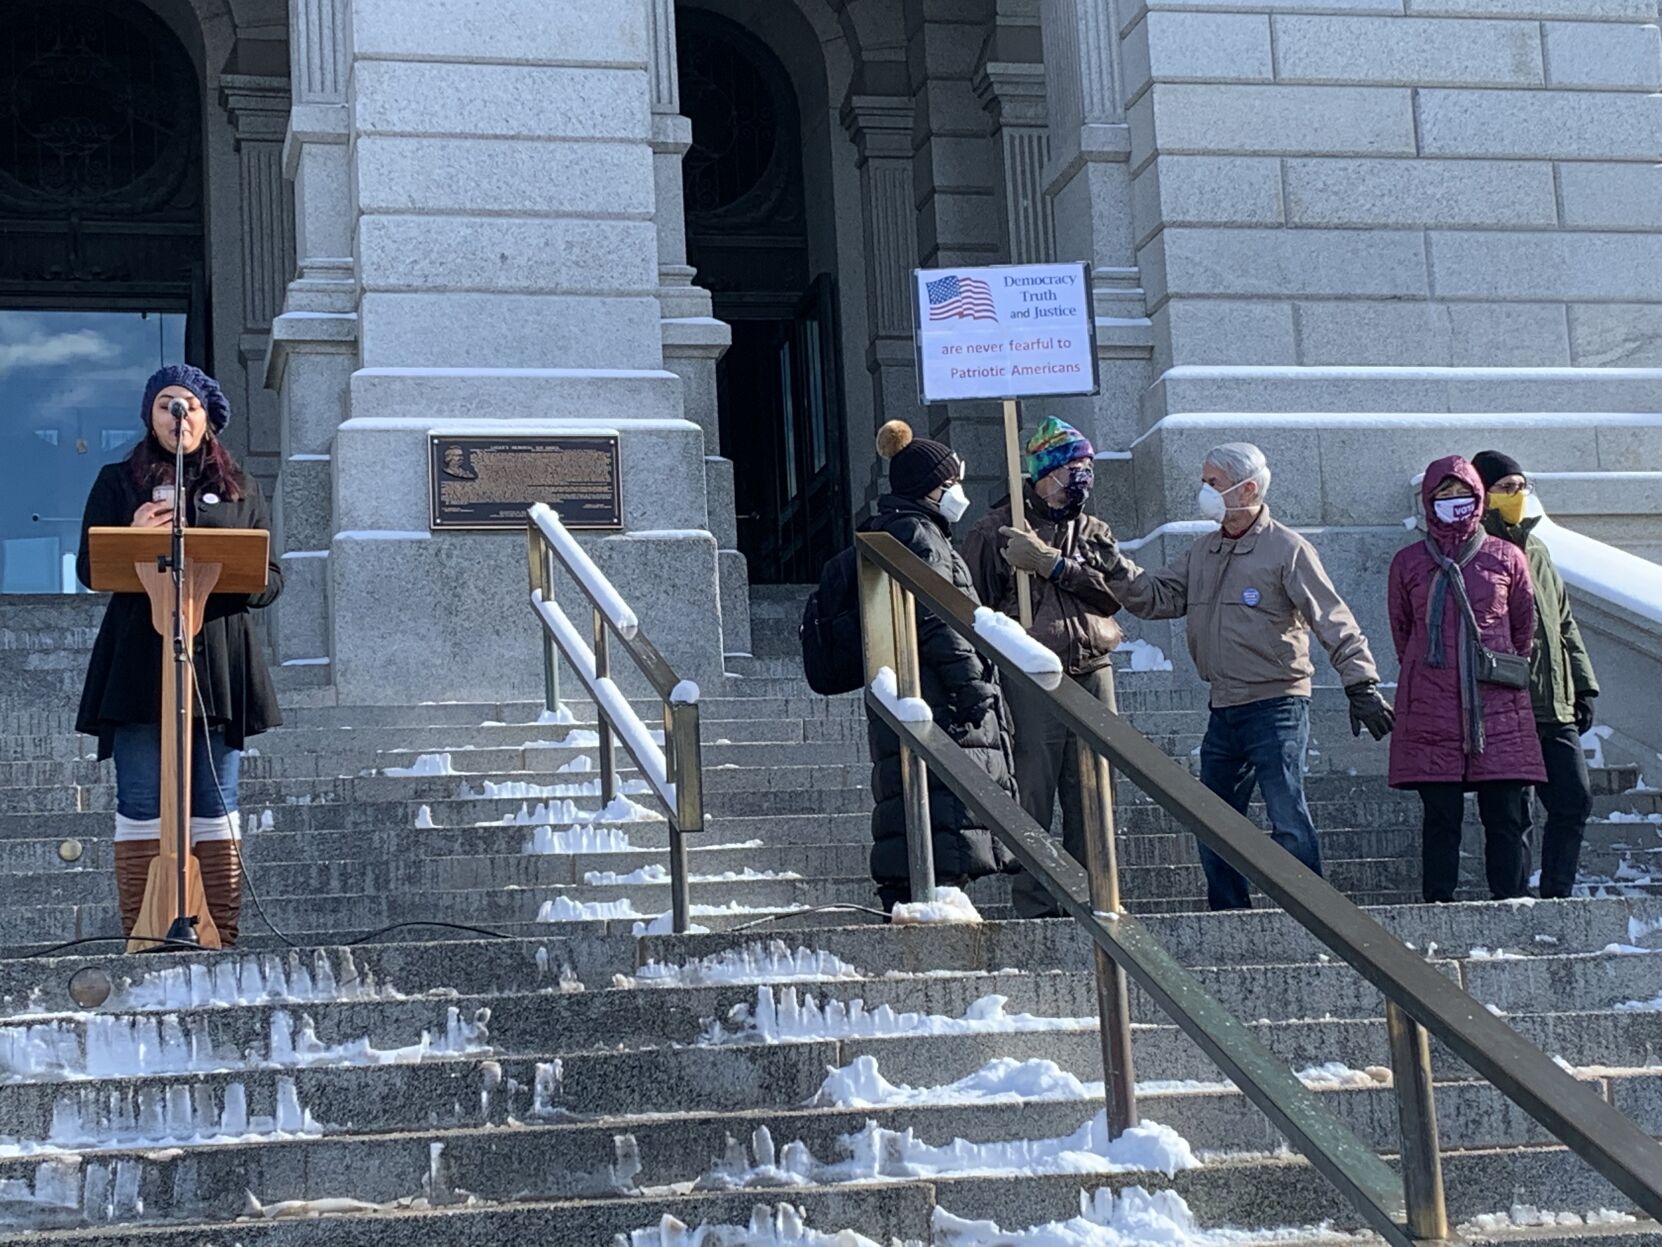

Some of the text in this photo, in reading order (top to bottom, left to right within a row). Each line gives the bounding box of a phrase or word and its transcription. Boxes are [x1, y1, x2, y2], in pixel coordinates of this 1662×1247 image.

[1004, 274, 1077, 287] Democracy
[1021, 290, 1057, 302] Truth
[1010, 305, 1077, 319] and Justice
[941, 338, 1071, 355] are never fearful to
[951, 363, 1080, 379] Patriotic Americans
